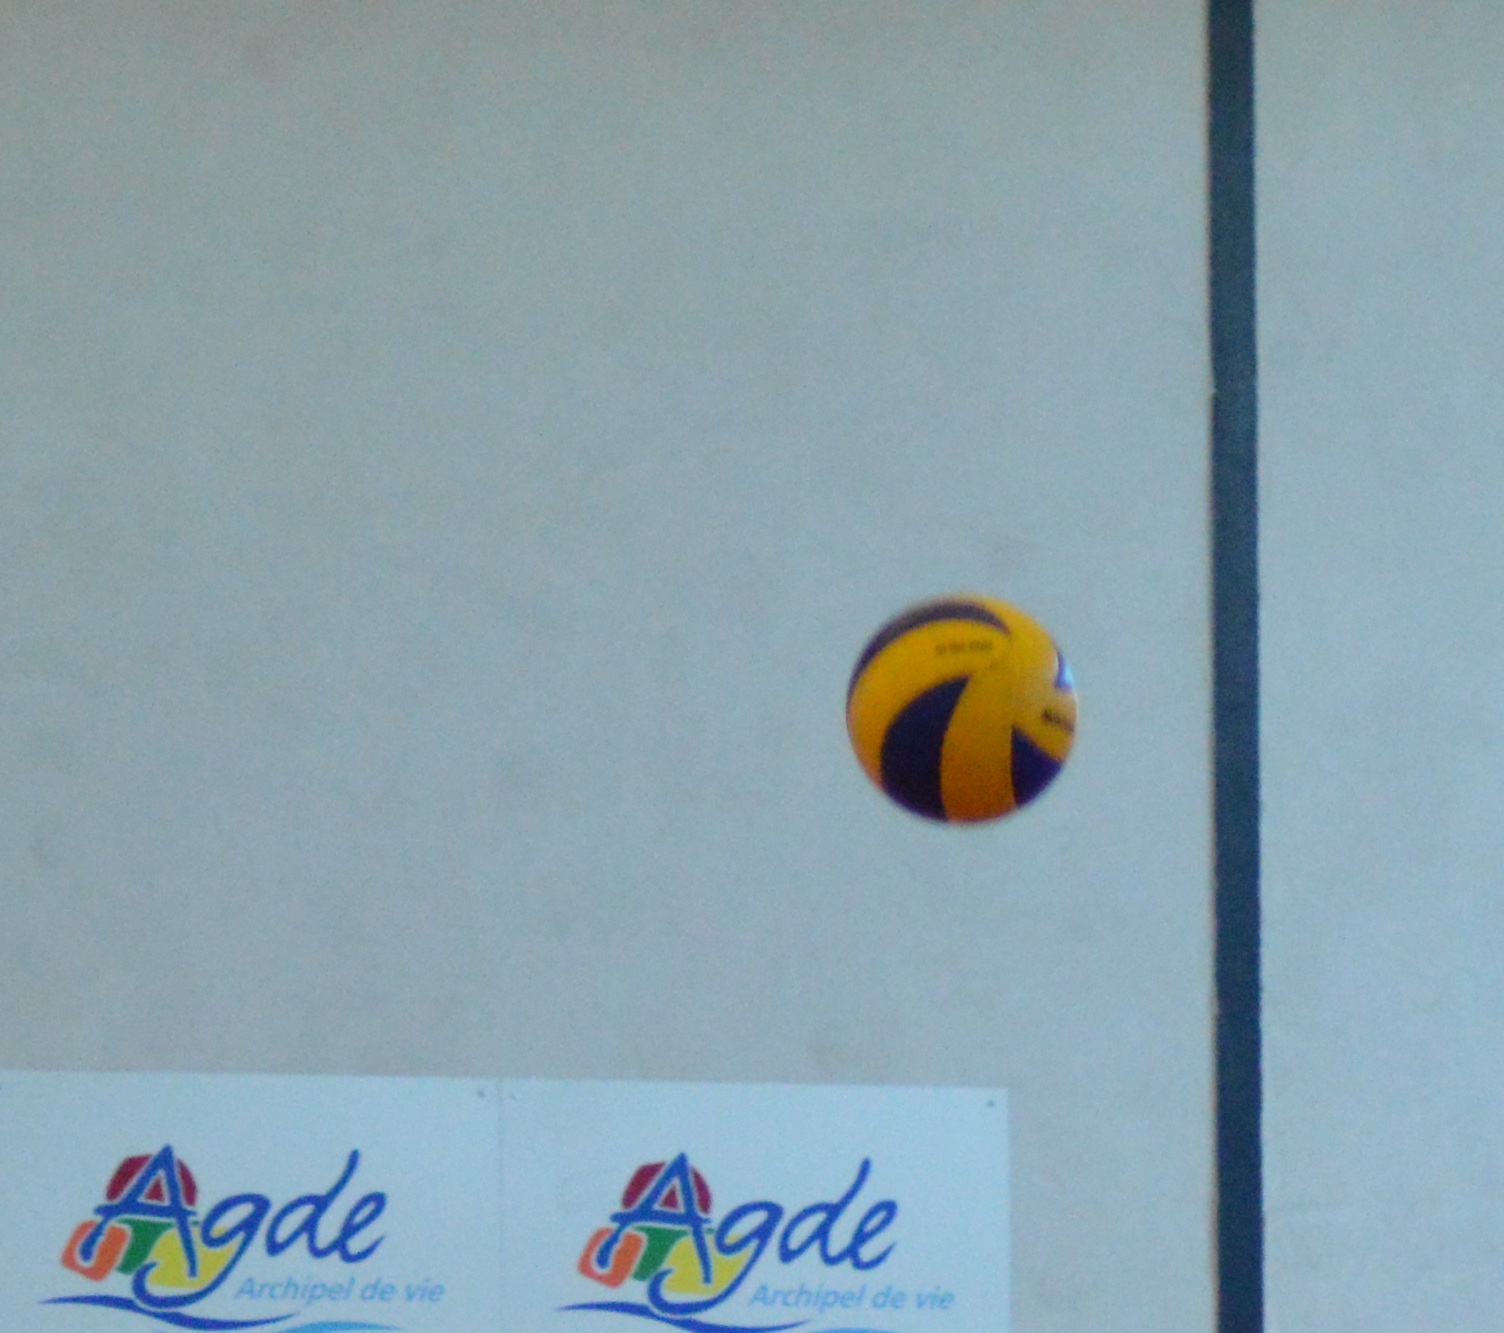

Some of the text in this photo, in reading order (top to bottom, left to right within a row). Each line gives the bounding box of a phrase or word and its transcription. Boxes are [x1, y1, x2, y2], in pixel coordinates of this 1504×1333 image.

[78, 1143, 389, 1310] Agde
[595, 1152, 899, 1316] Agde
[234, 1276, 446, 1307] Archipel de vie
[750, 1284, 957, 1314] Archipel de vie
